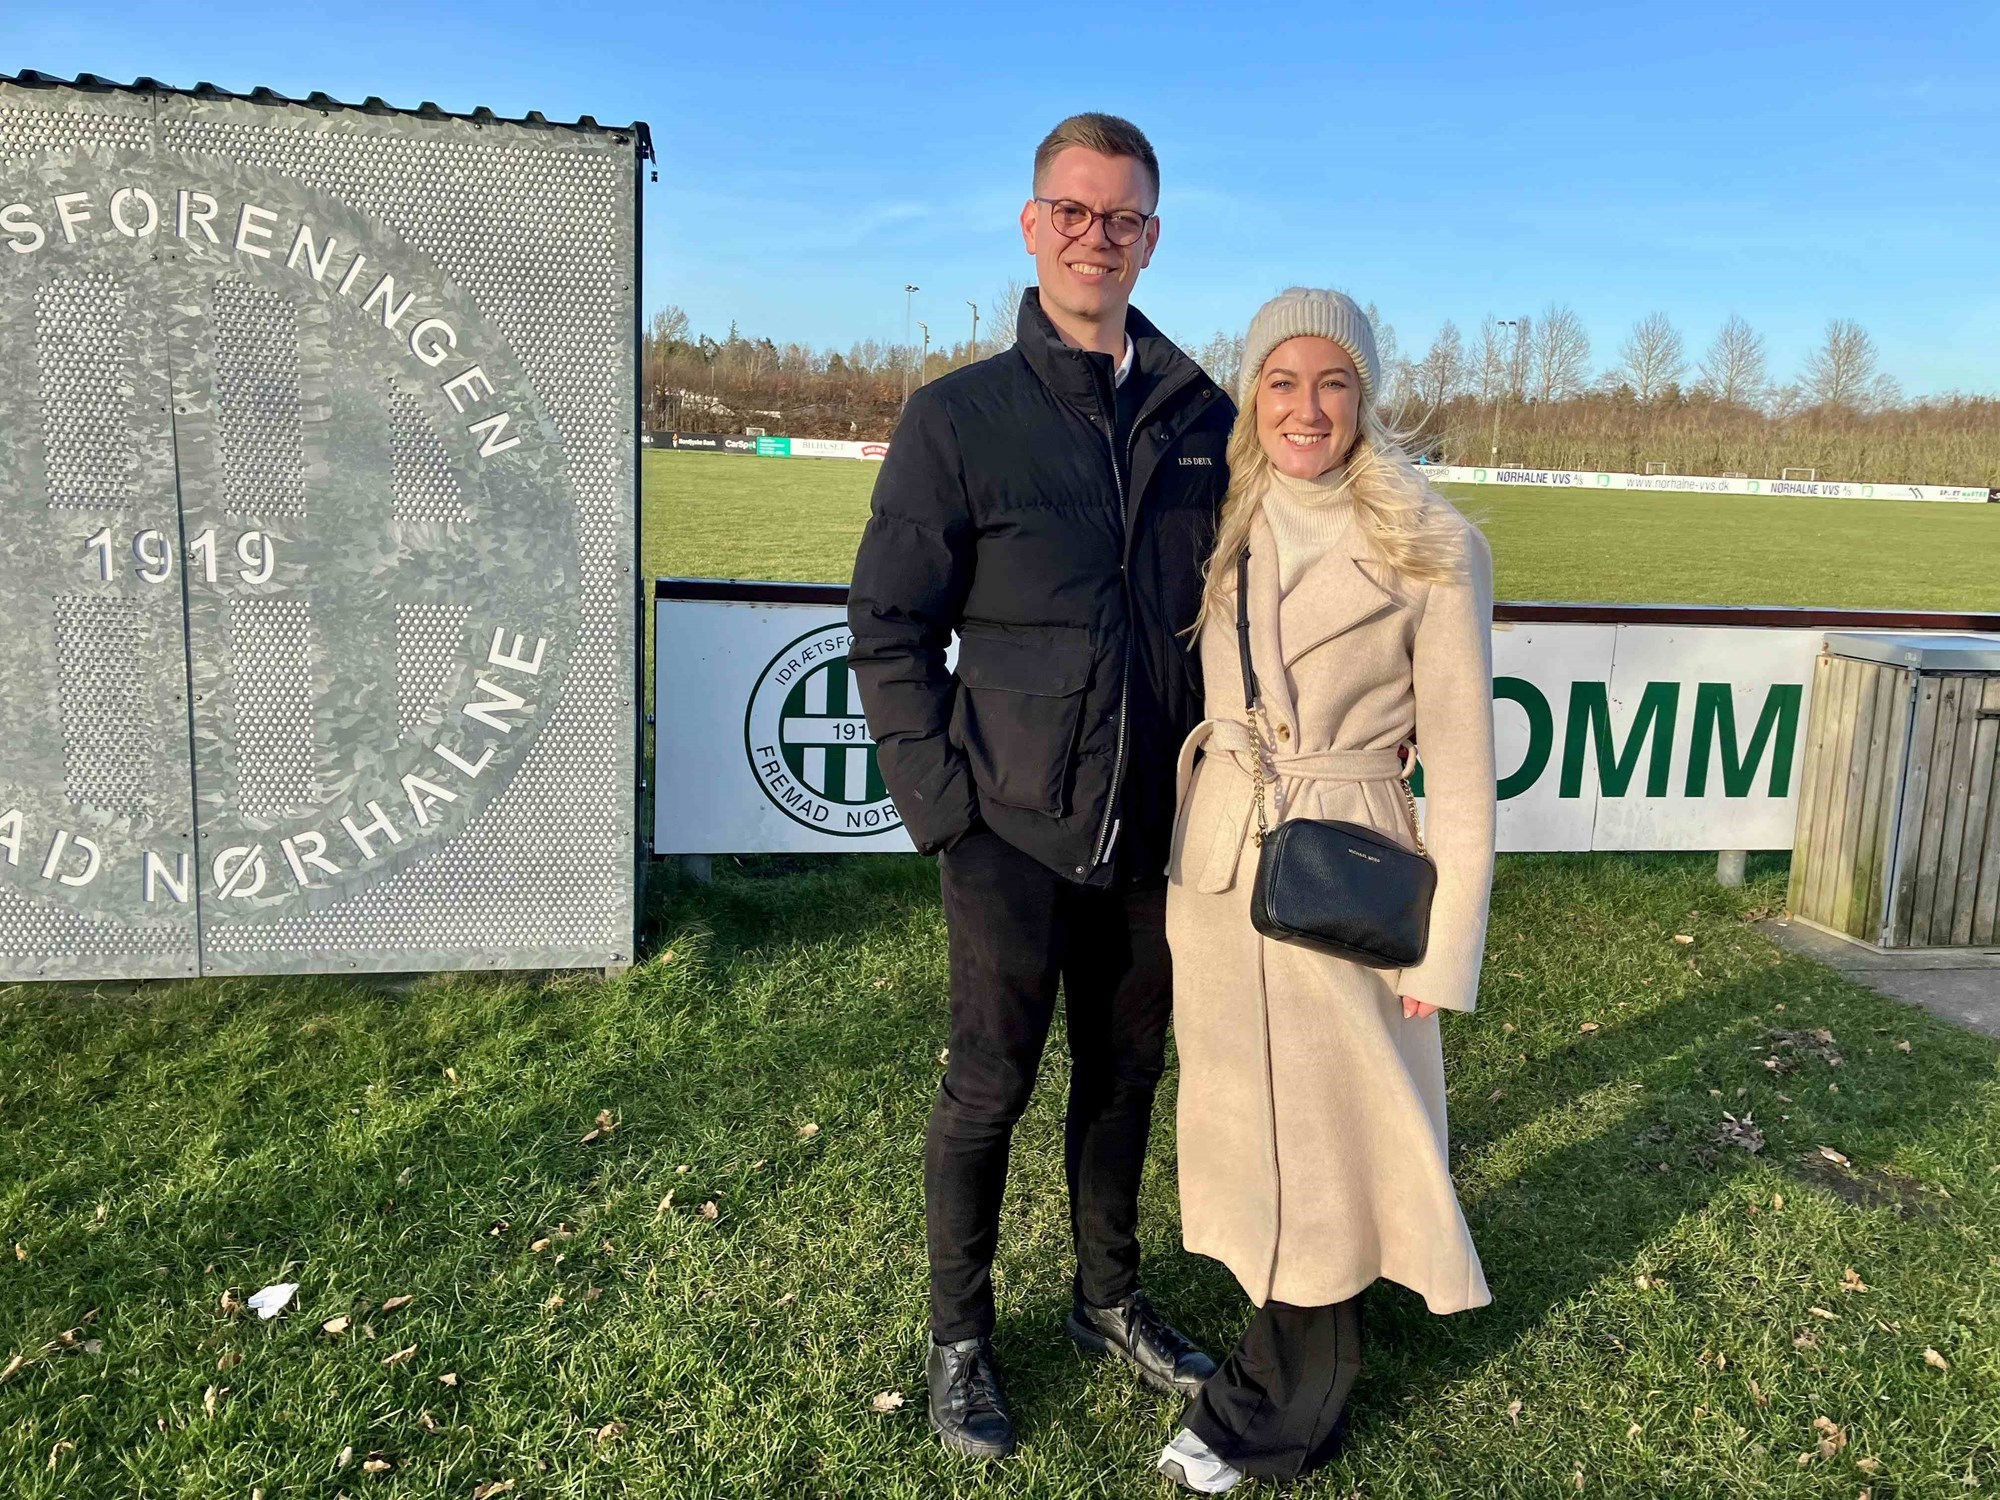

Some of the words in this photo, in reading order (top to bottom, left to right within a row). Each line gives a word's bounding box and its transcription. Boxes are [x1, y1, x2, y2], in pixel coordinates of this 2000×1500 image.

[0, 187, 522, 459] SFORENINGEN
[1178, 457, 1193, 466] LES
[1193, 457, 1212, 466] DEUX
[1496, 471, 1548, 484] NØRHALNE
[1552, 473, 1571, 485] VVS
[1626, 477, 1729, 491] www.norhalne-vvs.dk
[1770, 482, 1818, 495] NØRHALNE
[1822, 485, 1840, 496] VVS
[85, 527, 274, 585] 1919
[142, 627, 547, 902] NØRHALNE
[756, 745, 829, 822] FREMAD
[846, 804, 899, 828] NØR
